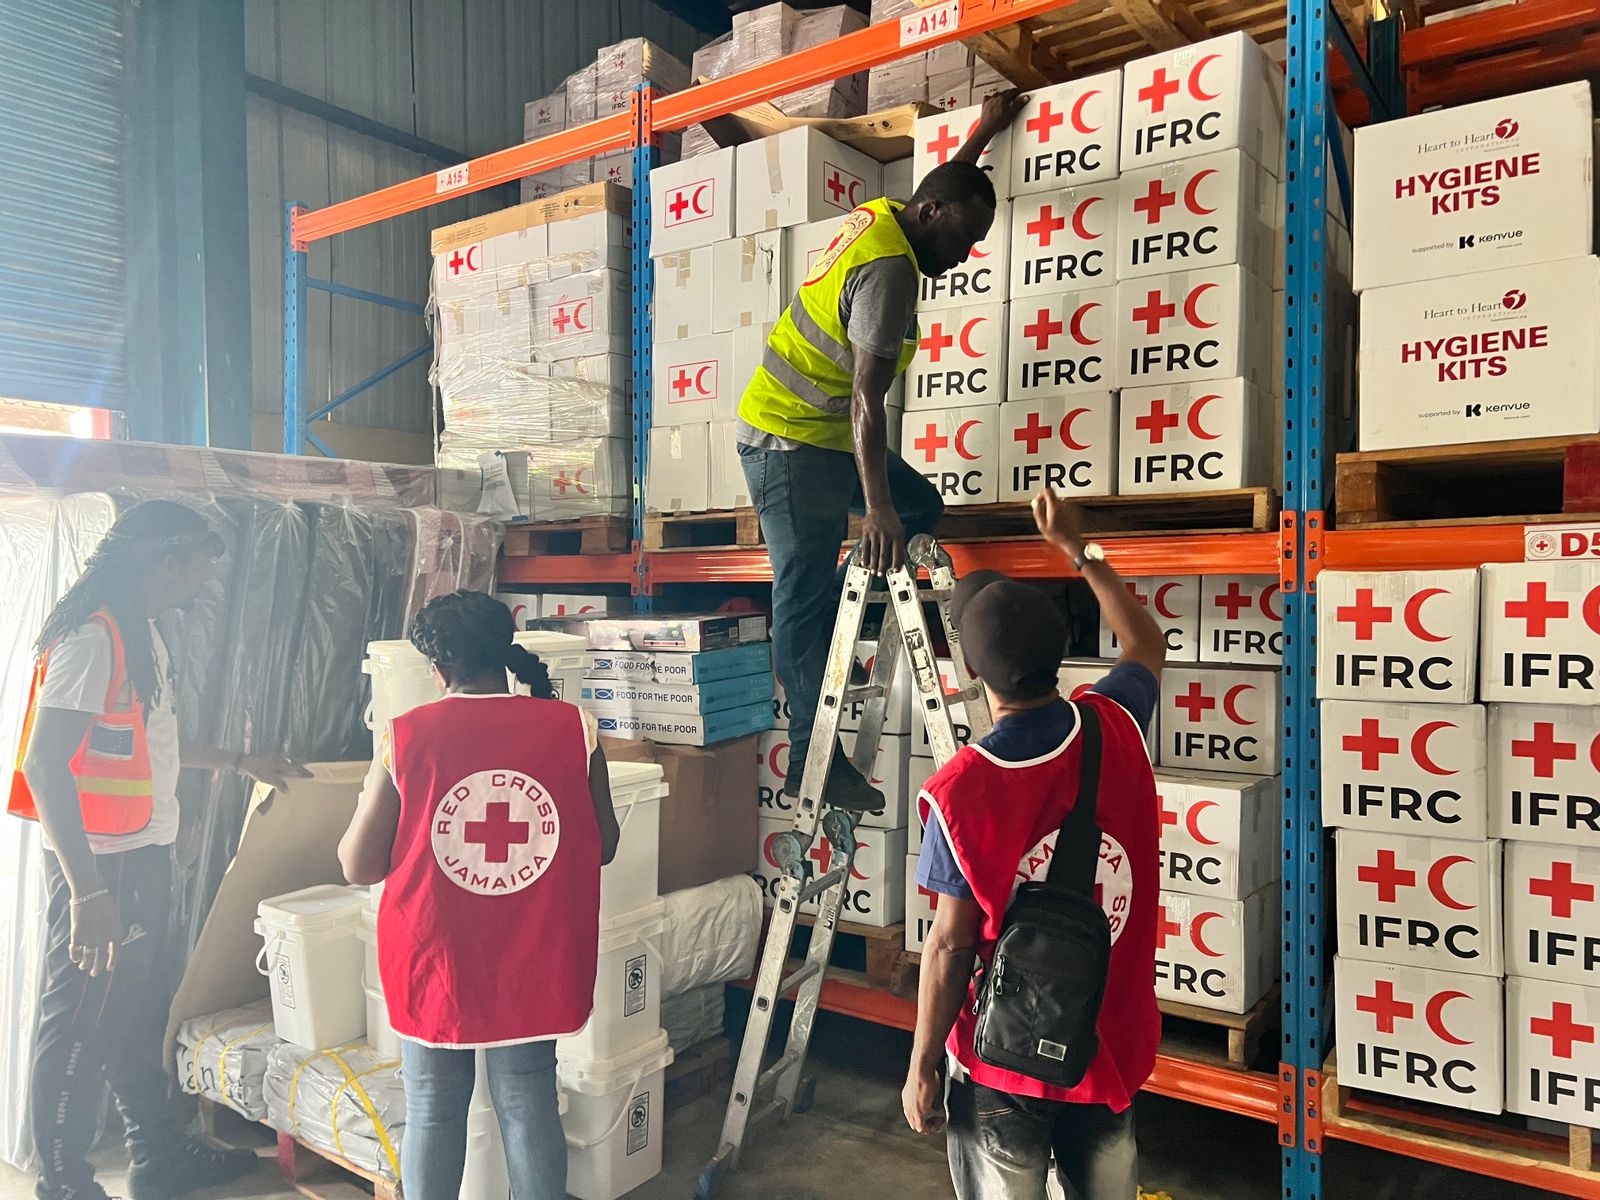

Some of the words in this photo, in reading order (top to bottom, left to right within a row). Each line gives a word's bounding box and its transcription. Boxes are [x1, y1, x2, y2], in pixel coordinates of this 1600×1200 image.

[918, 10, 948, 35] A14
[611, 101, 626, 110] IFRC
[1136, 112, 1221, 155] IFRC
[1418, 142, 1446, 154] Heart
[1464, 133, 1494, 144] Heart
[448, 170, 463, 186] A15
[1025, 144, 1101, 183] IFRC
[1395, 152, 1540, 199] HYGIENE
[1432, 186, 1500, 215] KITS
[1132, 226, 1218, 265] IFRC
[1412, 243, 1445, 254] supported
[1025, 250, 1103, 285] IFRC
[922, 269, 991, 301] IFRC
[1424, 309, 1454, 320] Heart
[1472, 302, 1501, 312] Heart
[1131, 340, 1219, 375] IFRC
[1401, 325, 1548, 364] HYGIENE
[917, 368, 987, 398] IFRC
[1022, 356, 1101, 388] IFRC
[1438, 356, 1507, 382] KITS
[1418, 410, 1451, 418] supported
[1013, 461, 1092, 491] IFRC
[1135, 452, 1223, 483] IFRC
[1112, 628, 1184, 652] IC
[1214, 630, 1283, 655] IFRC
[614, 661, 634, 669] FOOD
[636, 662, 650, 670] FOR
[1337, 655, 1453, 690] IFRC
[1505, 653, 1600, 690] IFR
[654, 693, 668, 701] THE
[670, 694, 692, 703] POOR
[619, 721, 640, 730] FOOD
[642, 723, 656, 731] FOR
[674, 725, 697, 734] POOR
[1175, 732, 1257, 761] IFRC
[438, 786, 470, 834] RED
[492, 774, 555, 835] CROSS
[1343, 784, 1462, 824] IFRC
[1512, 791, 1600, 832] IFR
[444, 855, 547, 889] JAMAICA
[1159, 851, 1221, 884] RC
[1359, 914, 1480, 958] IFRC
[1154, 961, 1226, 997] FRC
[1358, 1043, 1476, 1094] IFRC
